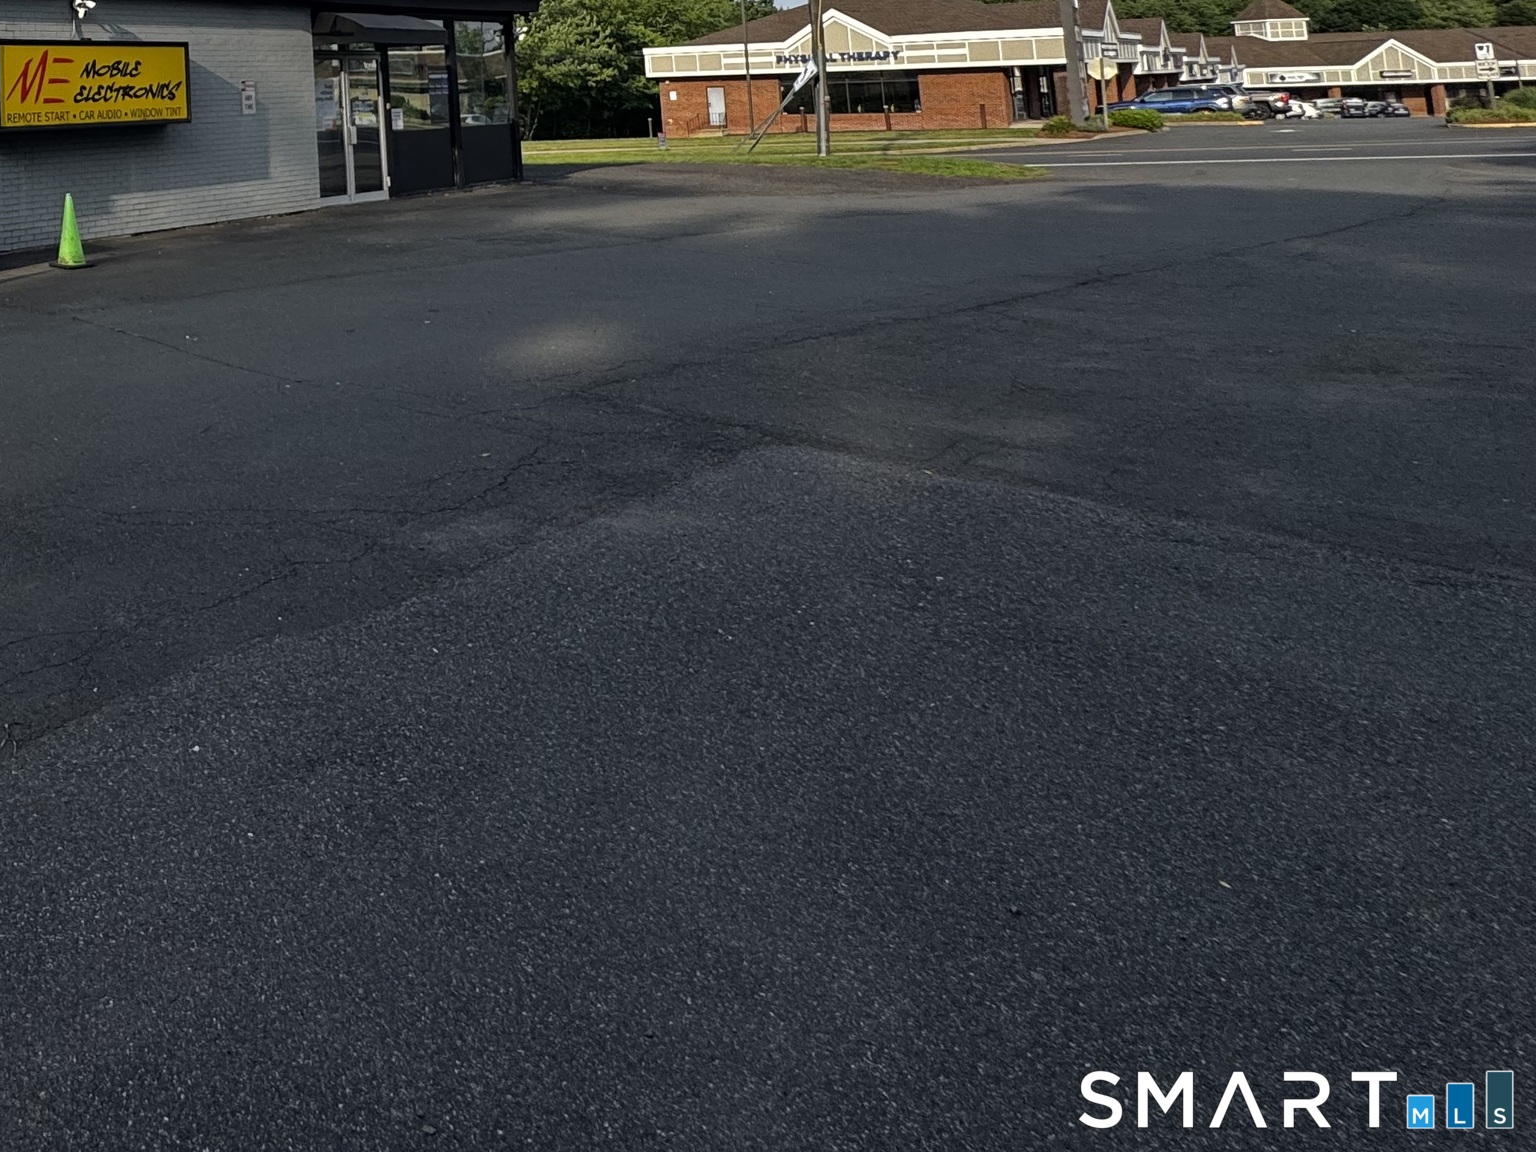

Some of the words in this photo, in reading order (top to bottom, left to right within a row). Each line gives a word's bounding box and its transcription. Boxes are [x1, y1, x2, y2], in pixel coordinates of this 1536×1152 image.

[839, 50, 900, 62] THERAPY
[80, 59, 142, 79] MOBILE
[73, 80, 183, 104] ELECTRONICS
[7, 112, 42, 123] REMOTE
[44, 110, 70, 122] START
[78, 109, 95, 120] CAR
[97, 108, 123, 119] AUDIO
[129, 107, 163, 118] WINDOW
[165, 106, 182, 116] TINT
